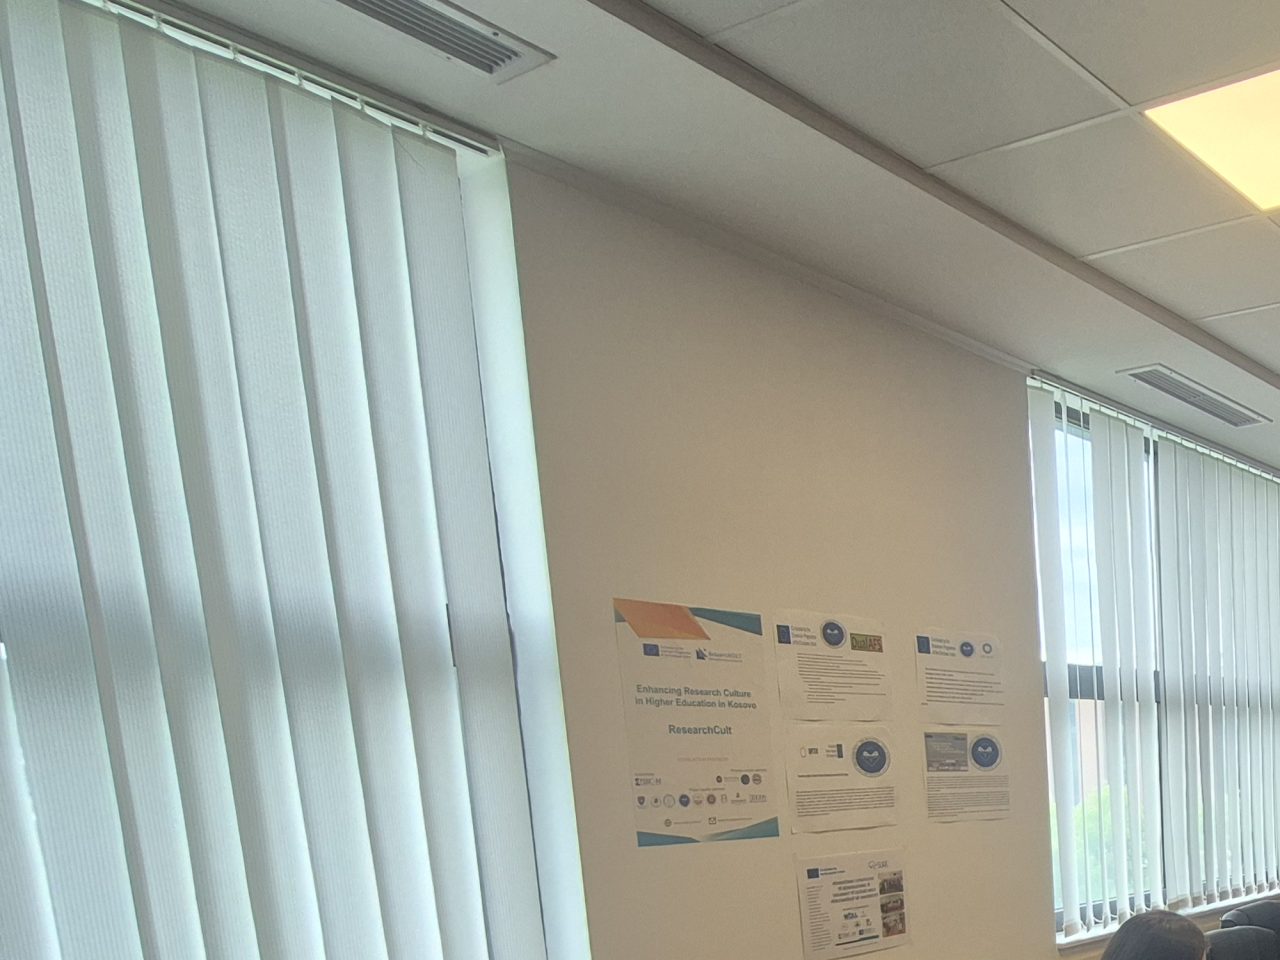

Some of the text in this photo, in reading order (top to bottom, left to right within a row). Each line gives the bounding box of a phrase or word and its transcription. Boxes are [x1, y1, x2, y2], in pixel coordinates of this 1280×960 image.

[636, 684, 751, 698] Enhancing Research Culture
[635, 696, 757, 709] in Higher Education in Kosovo
[668, 724, 732, 735] ResearchCult
